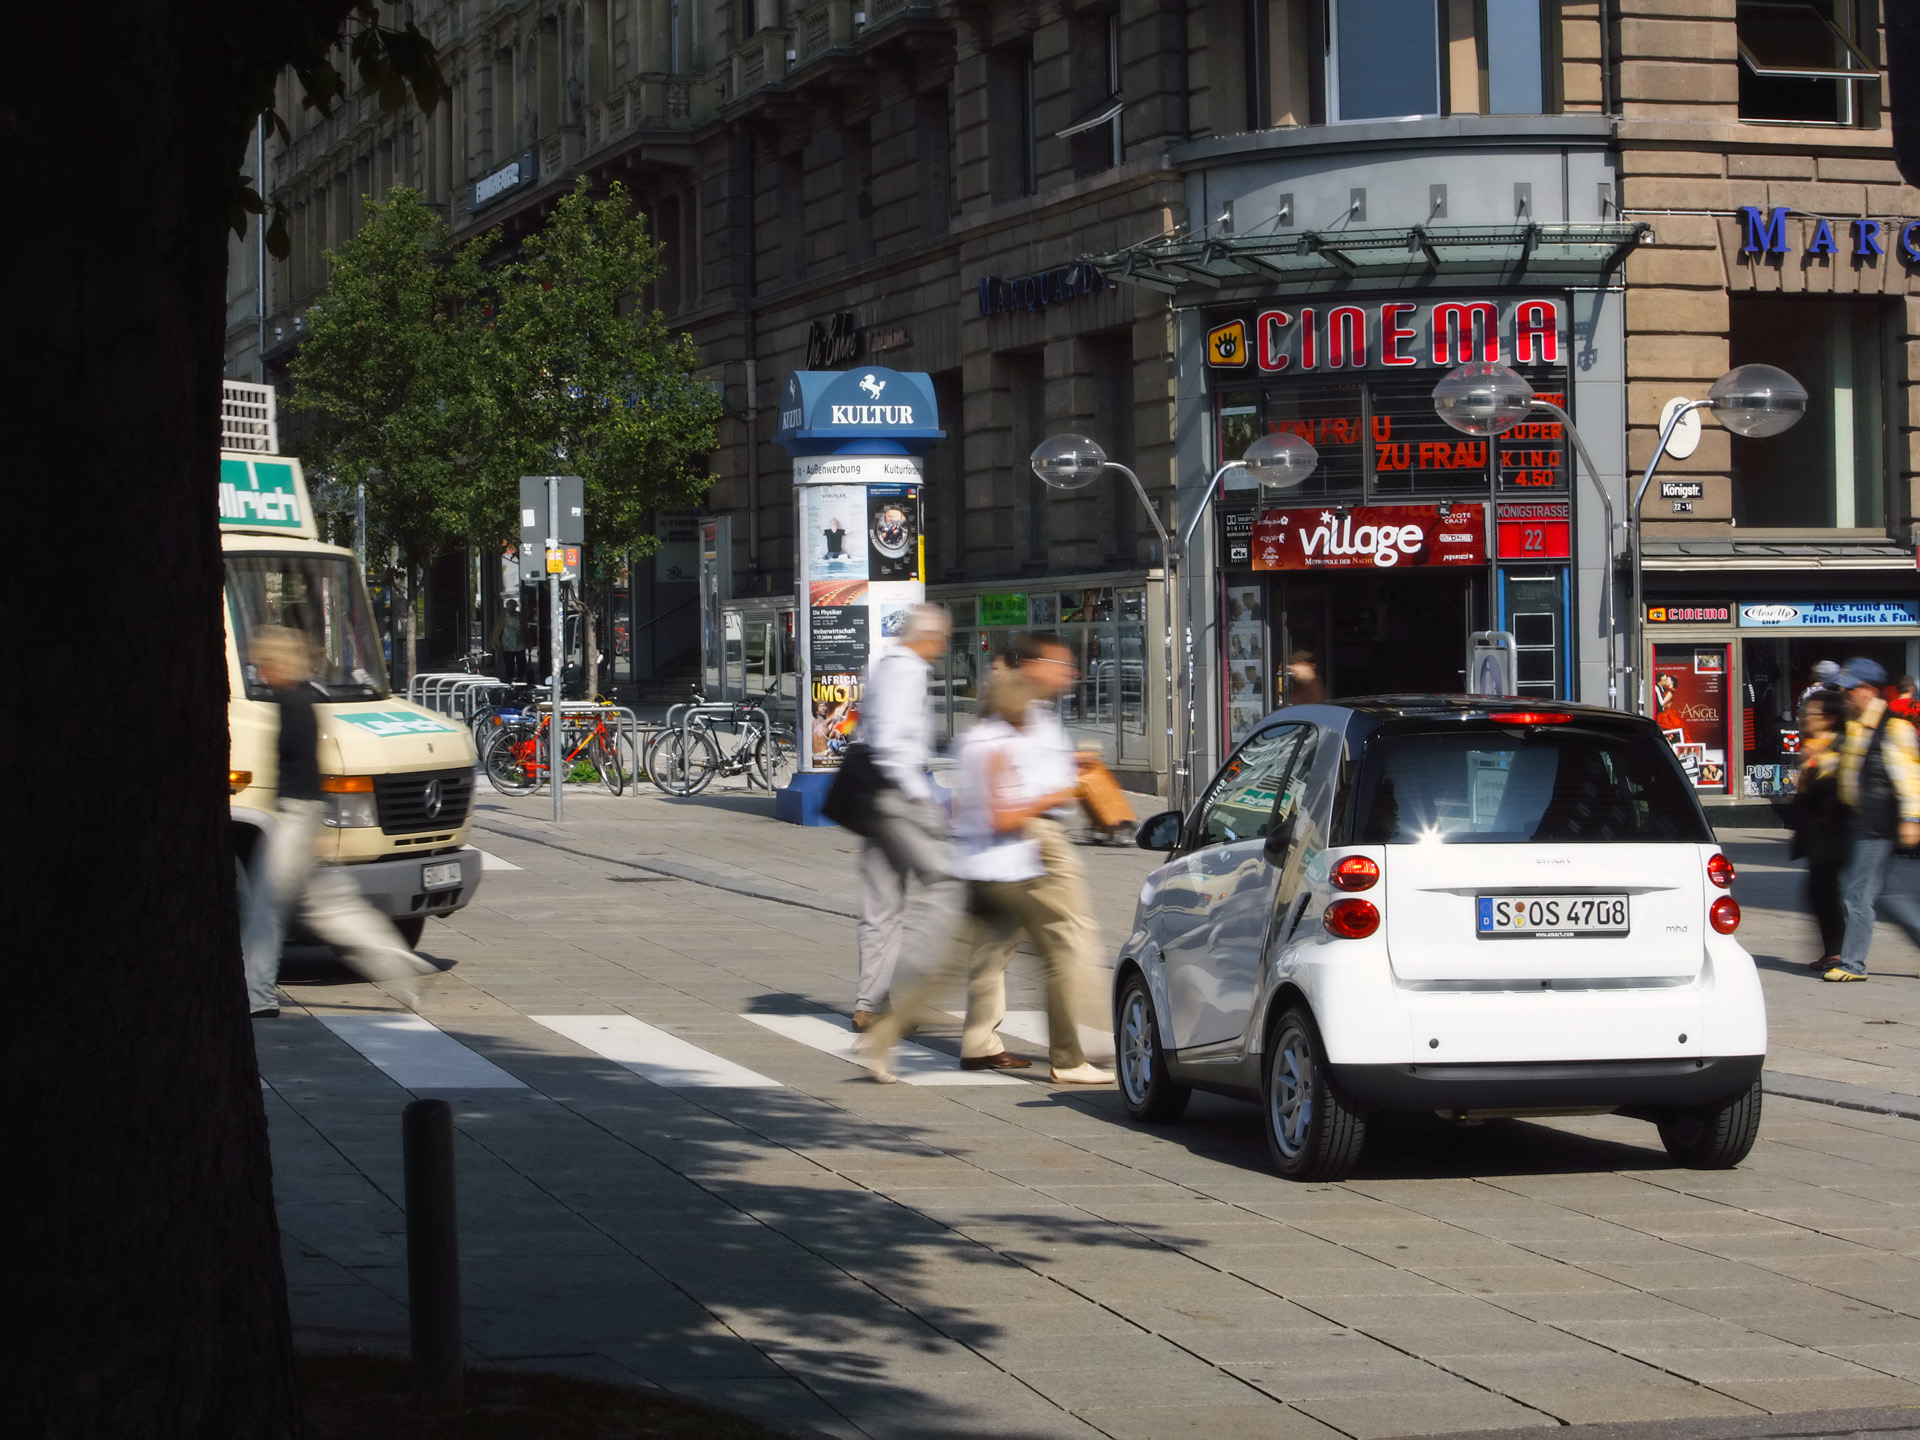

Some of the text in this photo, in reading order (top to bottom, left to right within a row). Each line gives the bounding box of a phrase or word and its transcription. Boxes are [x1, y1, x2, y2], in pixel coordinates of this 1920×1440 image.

[823, 312, 857, 367] Bohne
[1256, 299, 1558, 372] CINEMA
[831, 405, 914, 425] KULTUR
[1321, 415, 1391, 445] FRAU
[1499, 423, 1563, 440] SUPER
[1375, 440, 1487, 470] ZU FRAU
[1501, 450, 1560, 467] KINO
[807, 464, 861, 475] Außenwerbung
[1514, 469, 1555, 486] 4.50
[219, 461, 301, 522] llrich
[1662, 483, 1701, 499] Königstr.
[1497, 503, 1569, 519] KÖNIGSTRASSE
[1674, 503, 1681, 511] 22
[1298, 514, 1424, 567] village
[1524, 528, 1543, 551] 22
[1233, 549, 1246, 557] dts
[1304, 556, 1374, 566] METROPOLE DER NACHT
[1668, 608, 1728, 620] CINEMA
[1776, 606, 1792, 619] Up
[1813, 602, 1905, 612] Alles rund um
[1802, 613, 1835, 626] Film,
[1838, 612, 1876, 623] Musik
[1879, 613, 1888, 622] &
[821, 675, 858, 685] AFRICA
[1678, 703, 1719, 718] ANGEL
[1535, 856, 1571, 864] smart
[1483, 917, 1490, 925] D
[1495, 900, 1626, 926] S OS 4708
[1665, 925, 1688, 933] mhd
